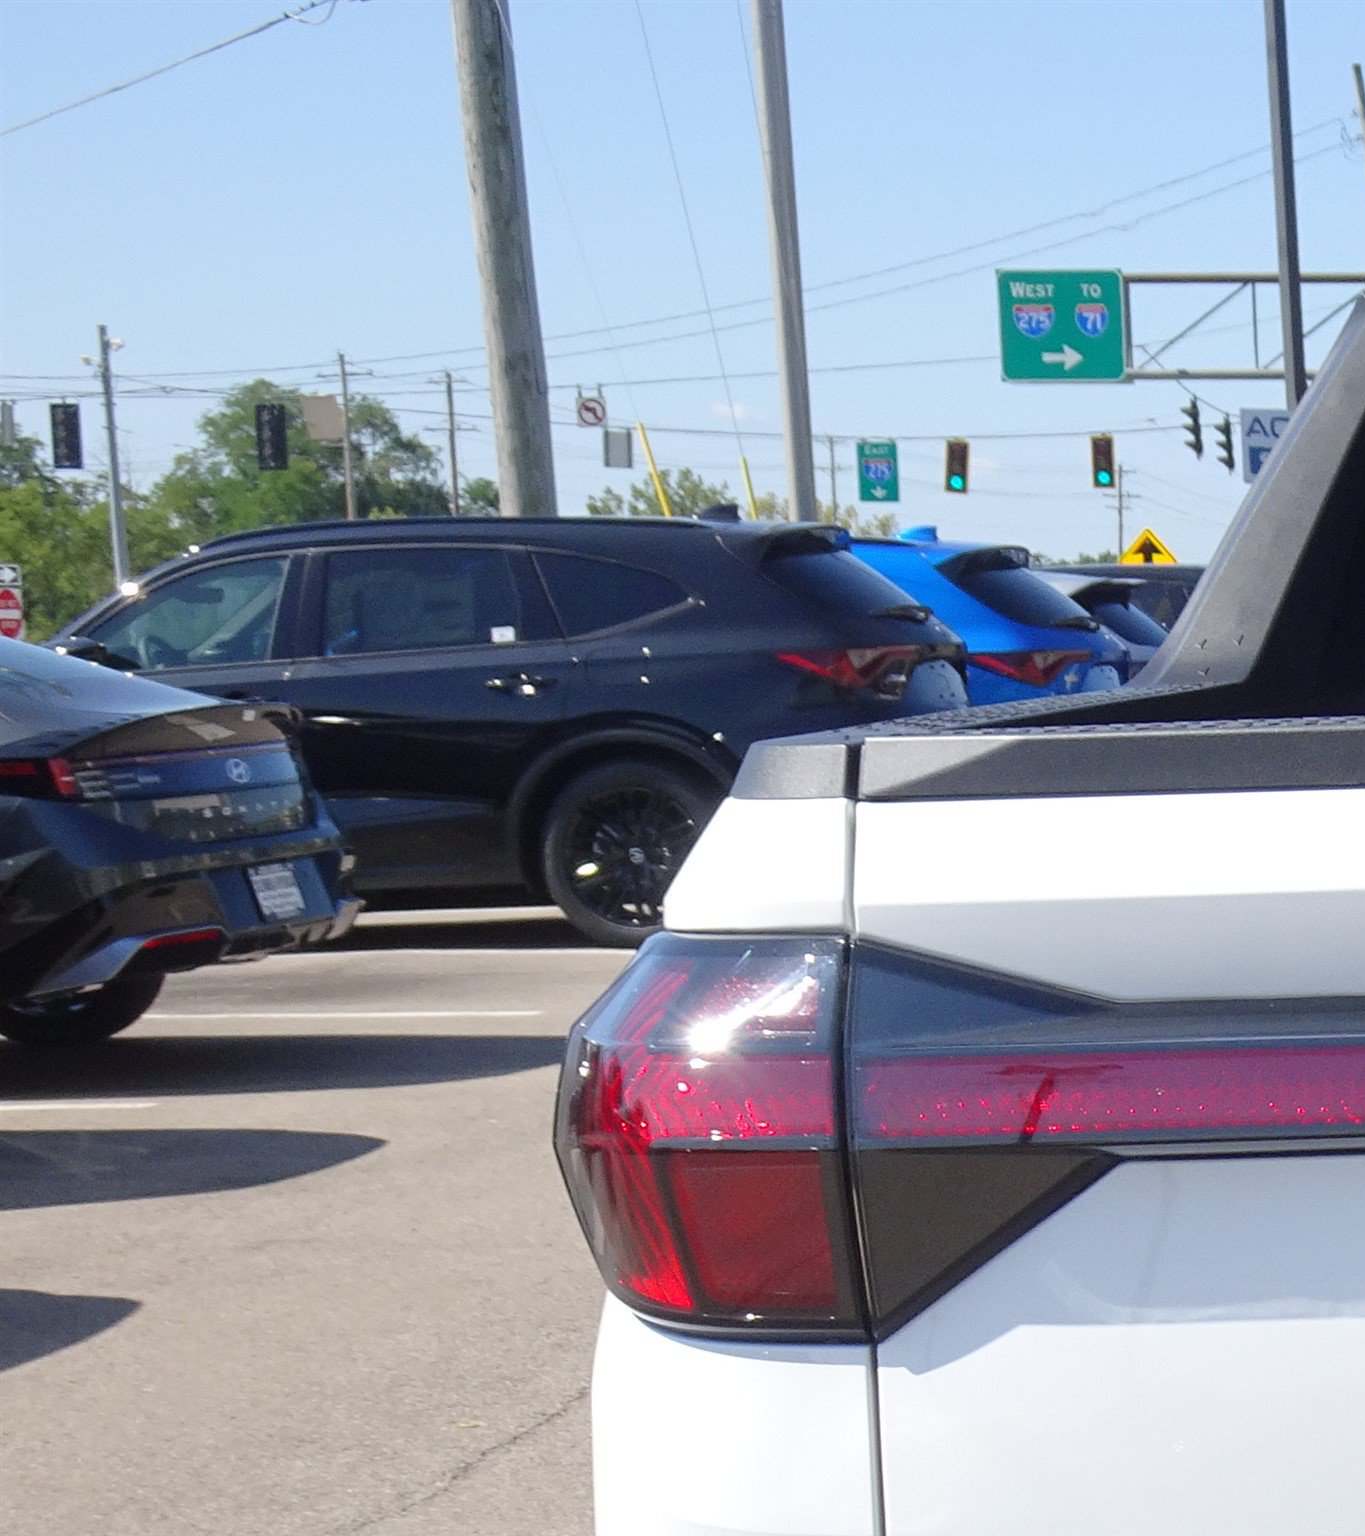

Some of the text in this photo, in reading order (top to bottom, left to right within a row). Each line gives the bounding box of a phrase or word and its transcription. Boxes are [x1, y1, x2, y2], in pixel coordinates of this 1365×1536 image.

[1009, 282, 1102, 298] WEST TO
[1018, 312, 1051, 329] 275
[1084, 311, 1103, 330] 71
